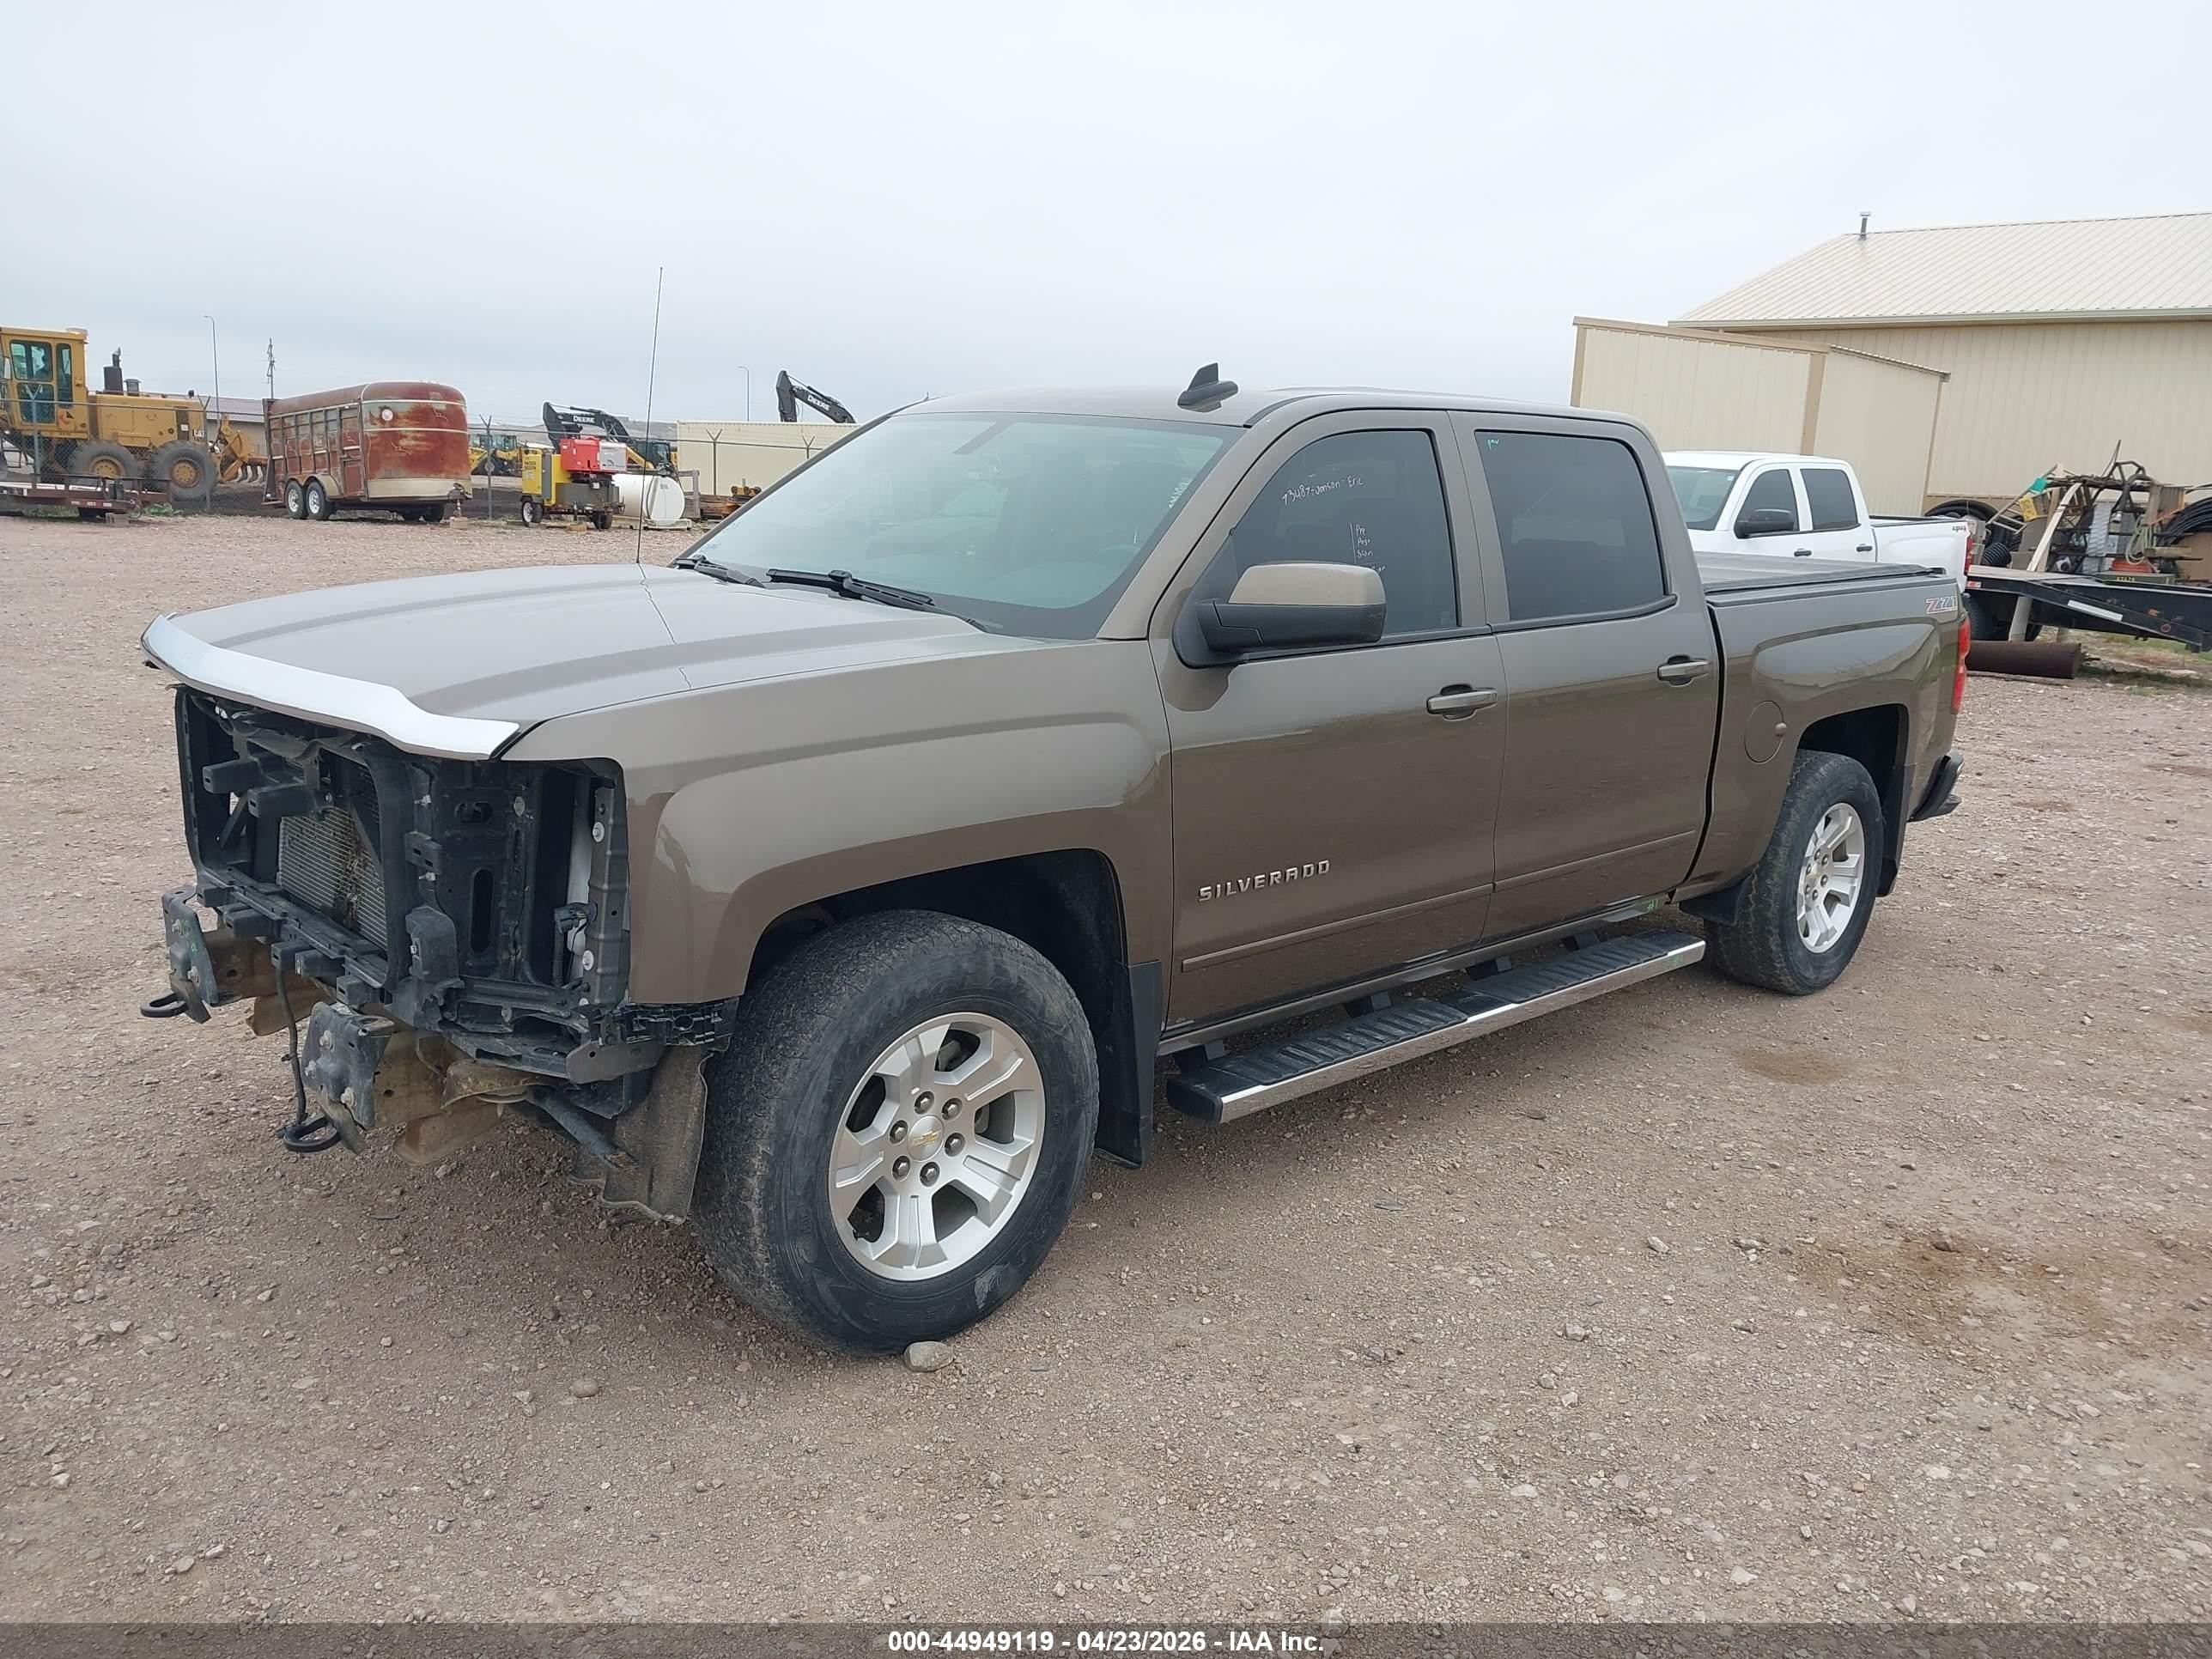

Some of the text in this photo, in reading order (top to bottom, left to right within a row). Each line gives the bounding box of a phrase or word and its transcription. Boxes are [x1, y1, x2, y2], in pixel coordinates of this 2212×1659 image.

[807, 394, 831, 411] DEERE
[573, 415, 596, 423] DEERE
[1925, 595, 1959, 615] Z71
[1199, 860, 1331, 902] SILVERADO
